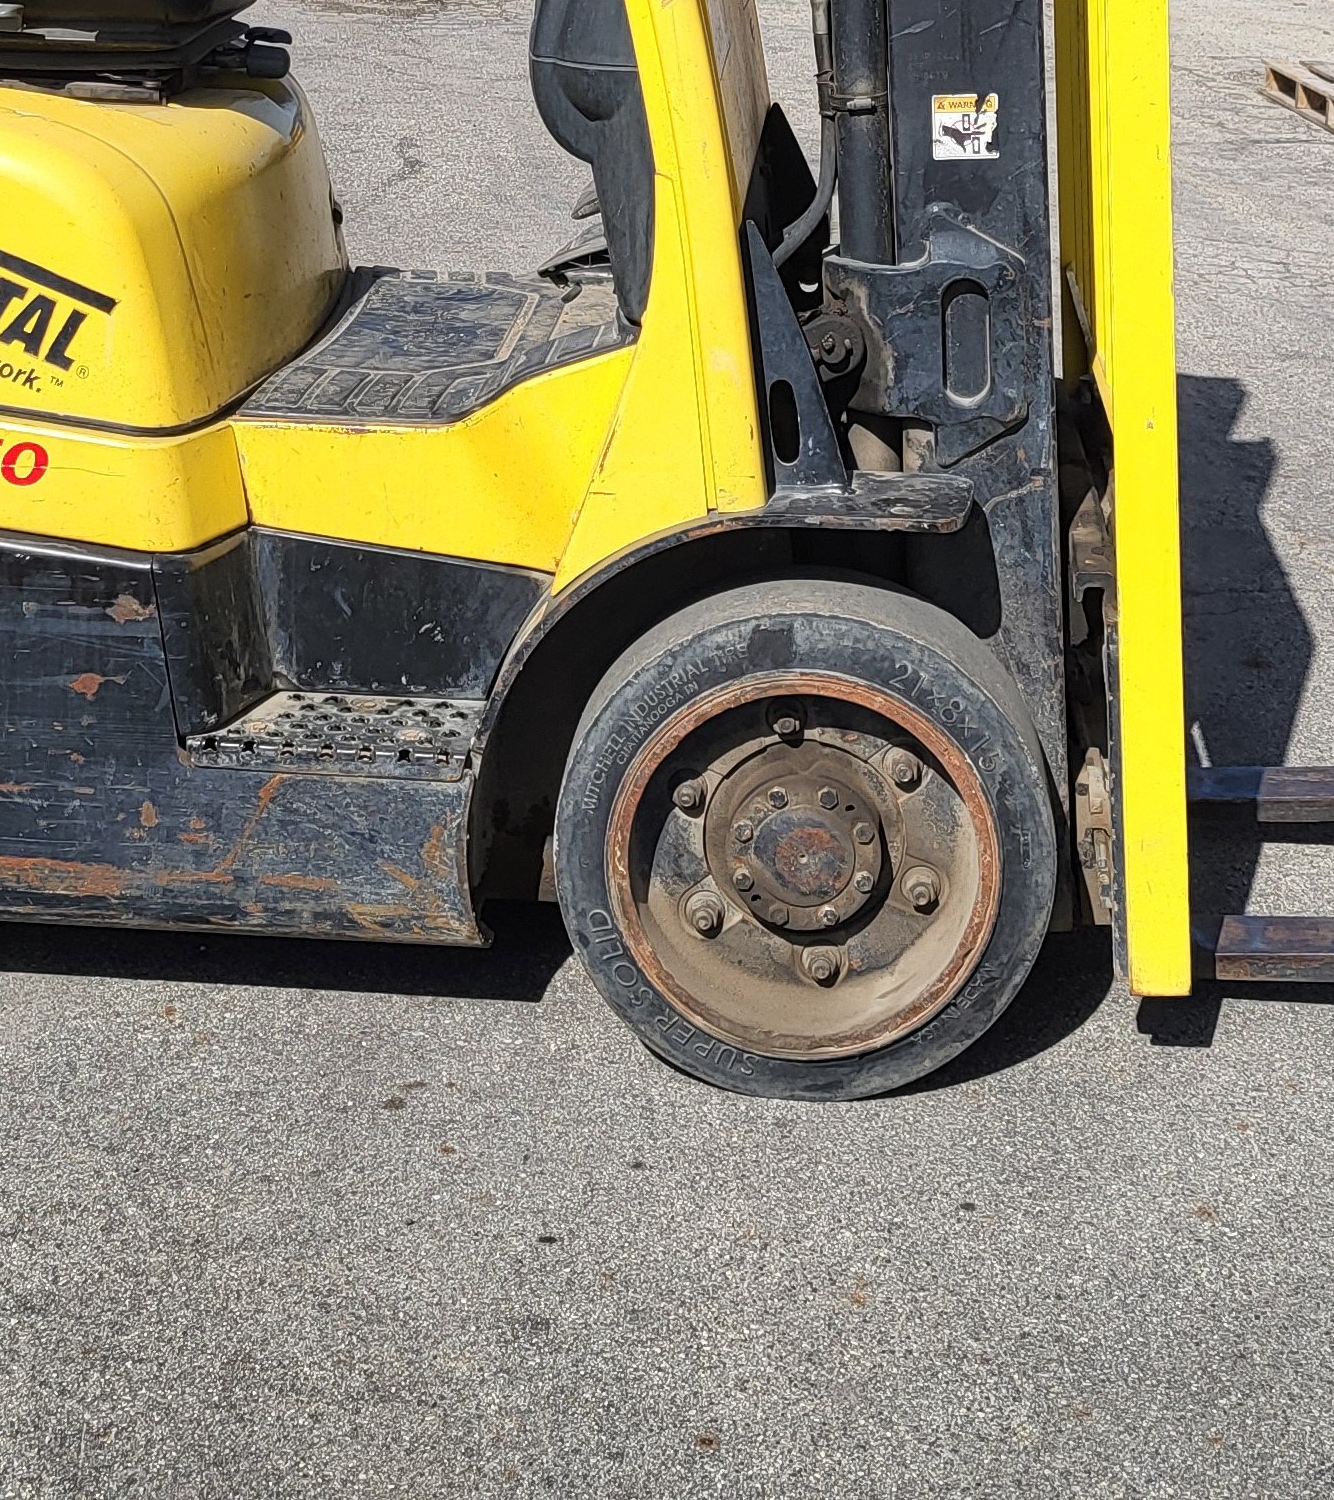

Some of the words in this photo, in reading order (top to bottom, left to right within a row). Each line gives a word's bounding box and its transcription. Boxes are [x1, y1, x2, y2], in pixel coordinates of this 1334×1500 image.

[948, 100, 993, 110] WARNG
[581, 733, 627, 815] MITCHELL
[621, 658, 709, 732] INDUSTRIAL
[588, 909, 654, 1008] SOLID
[655, 1008, 760, 1077] SUPER
